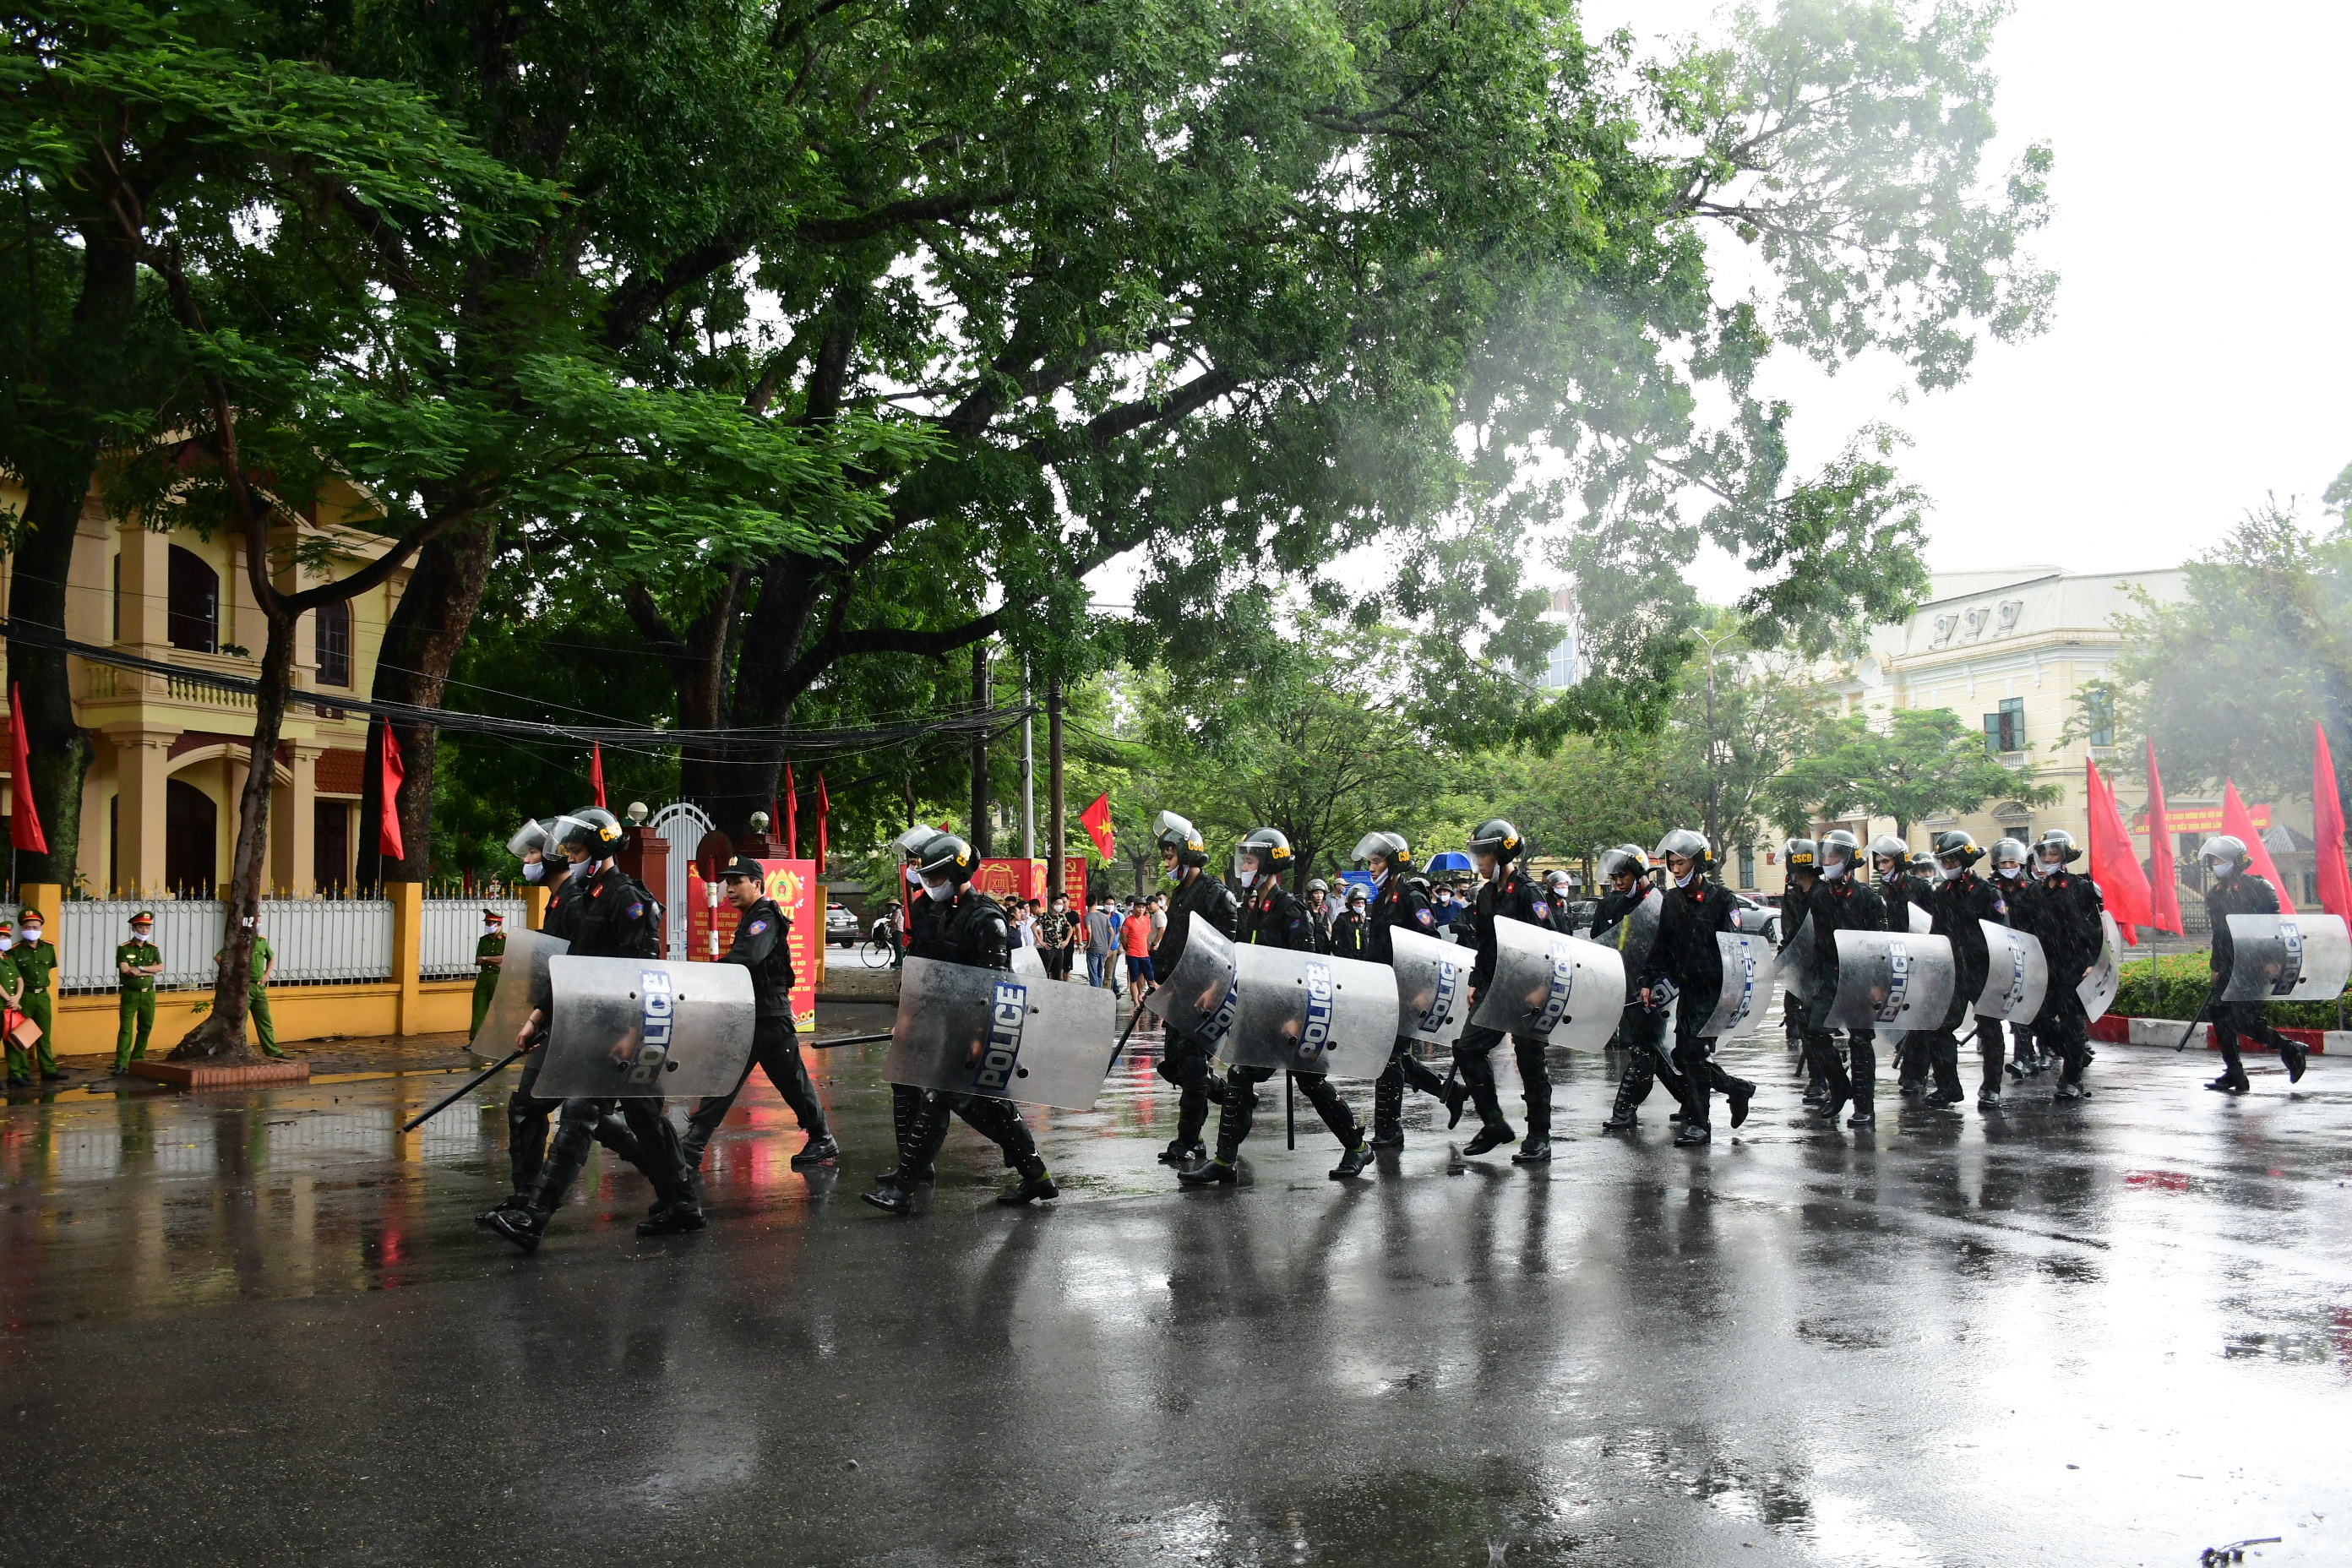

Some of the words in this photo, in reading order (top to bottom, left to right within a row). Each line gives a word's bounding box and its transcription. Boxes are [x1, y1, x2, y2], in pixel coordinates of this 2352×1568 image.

[242, 917, 254, 927] 02
[2274, 925, 2301, 994] POLICE
[1299, 964, 1332, 1058] POLICE
[1423, 947, 1455, 1031] POLICE
[1534, 943, 1571, 1031] POLICE
[1729, 945, 1753, 1026] POLICE
[1880, 943, 1908, 1020] POLICE
[2002, 938, 2023, 1011] POLICE
[628, 972, 672, 1084] POLICE
[977, 985, 1024, 1087] POLICE
